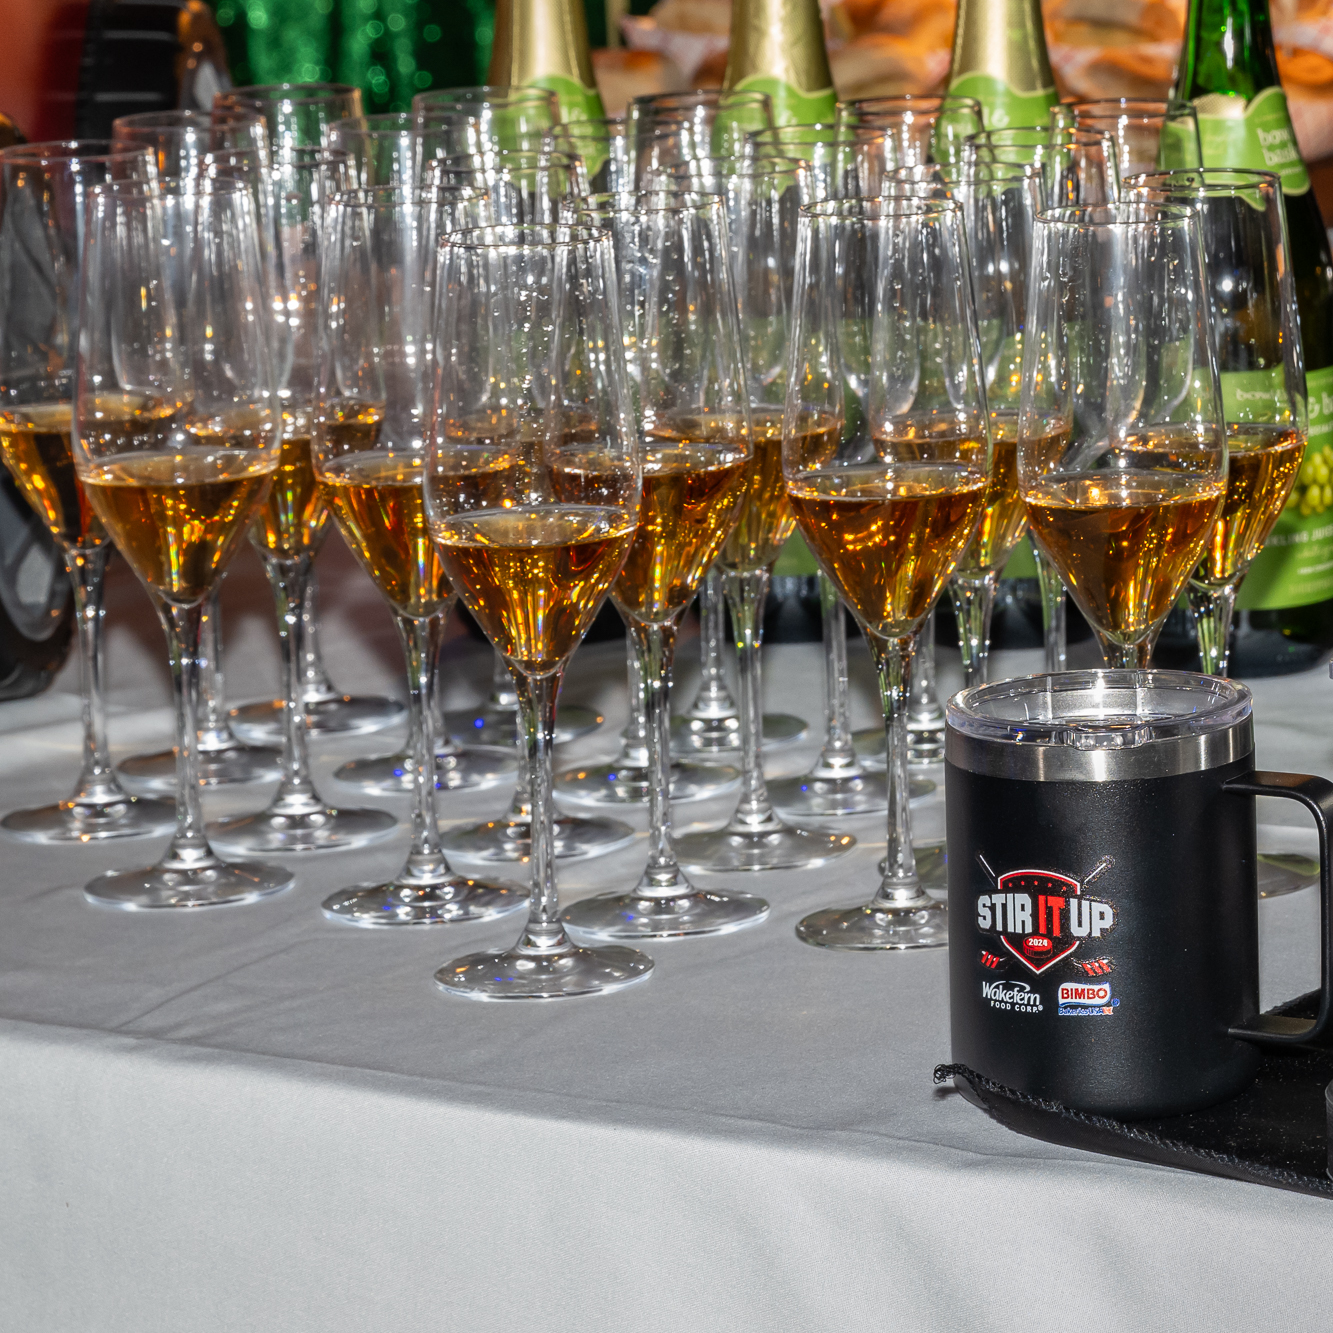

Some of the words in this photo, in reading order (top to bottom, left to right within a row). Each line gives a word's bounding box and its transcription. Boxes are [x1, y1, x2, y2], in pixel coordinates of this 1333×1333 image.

[977, 893, 1033, 934] STIR
[1038, 894, 1066, 937] IT
[1069, 897, 1114, 937] UP
[1027, 937, 1049, 948] 2024
[981, 980, 1041, 1006] Wakefern
[1060, 987, 1108, 1000] BIMBO
[990, 1000, 1012, 1010] FOOD
